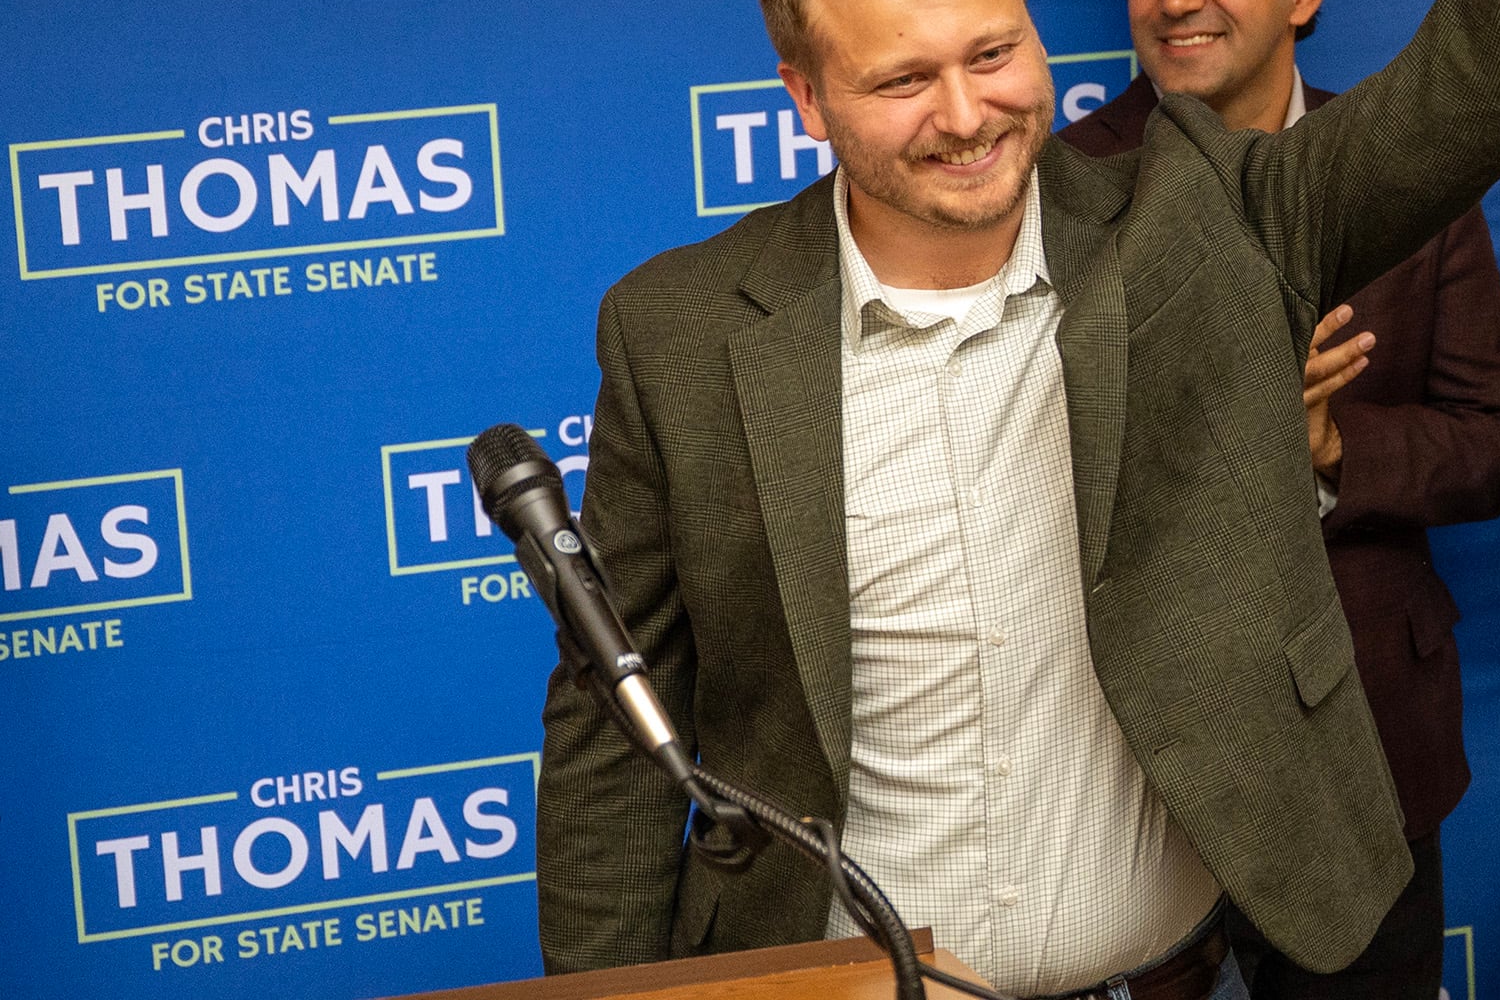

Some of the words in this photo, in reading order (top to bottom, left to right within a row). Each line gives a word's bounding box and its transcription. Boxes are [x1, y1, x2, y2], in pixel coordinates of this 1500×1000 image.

[197, 108, 315, 149] CHRIS
[38, 137, 474, 246] THOMAS
[96, 277, 171, 313] FOR
[184, 266, 293, 304] STATE
[305, 252, 439, 293] SENATE
[461, 570, 531, 605] FOR
[250, 766, 364, 808] CHRIS
[95, 787, 518, 909] THOMAS
[152, 935, 224, 971] FOR
[237, 917, 342, 959] STATE
[355, 897, 484, 942] SENATE
